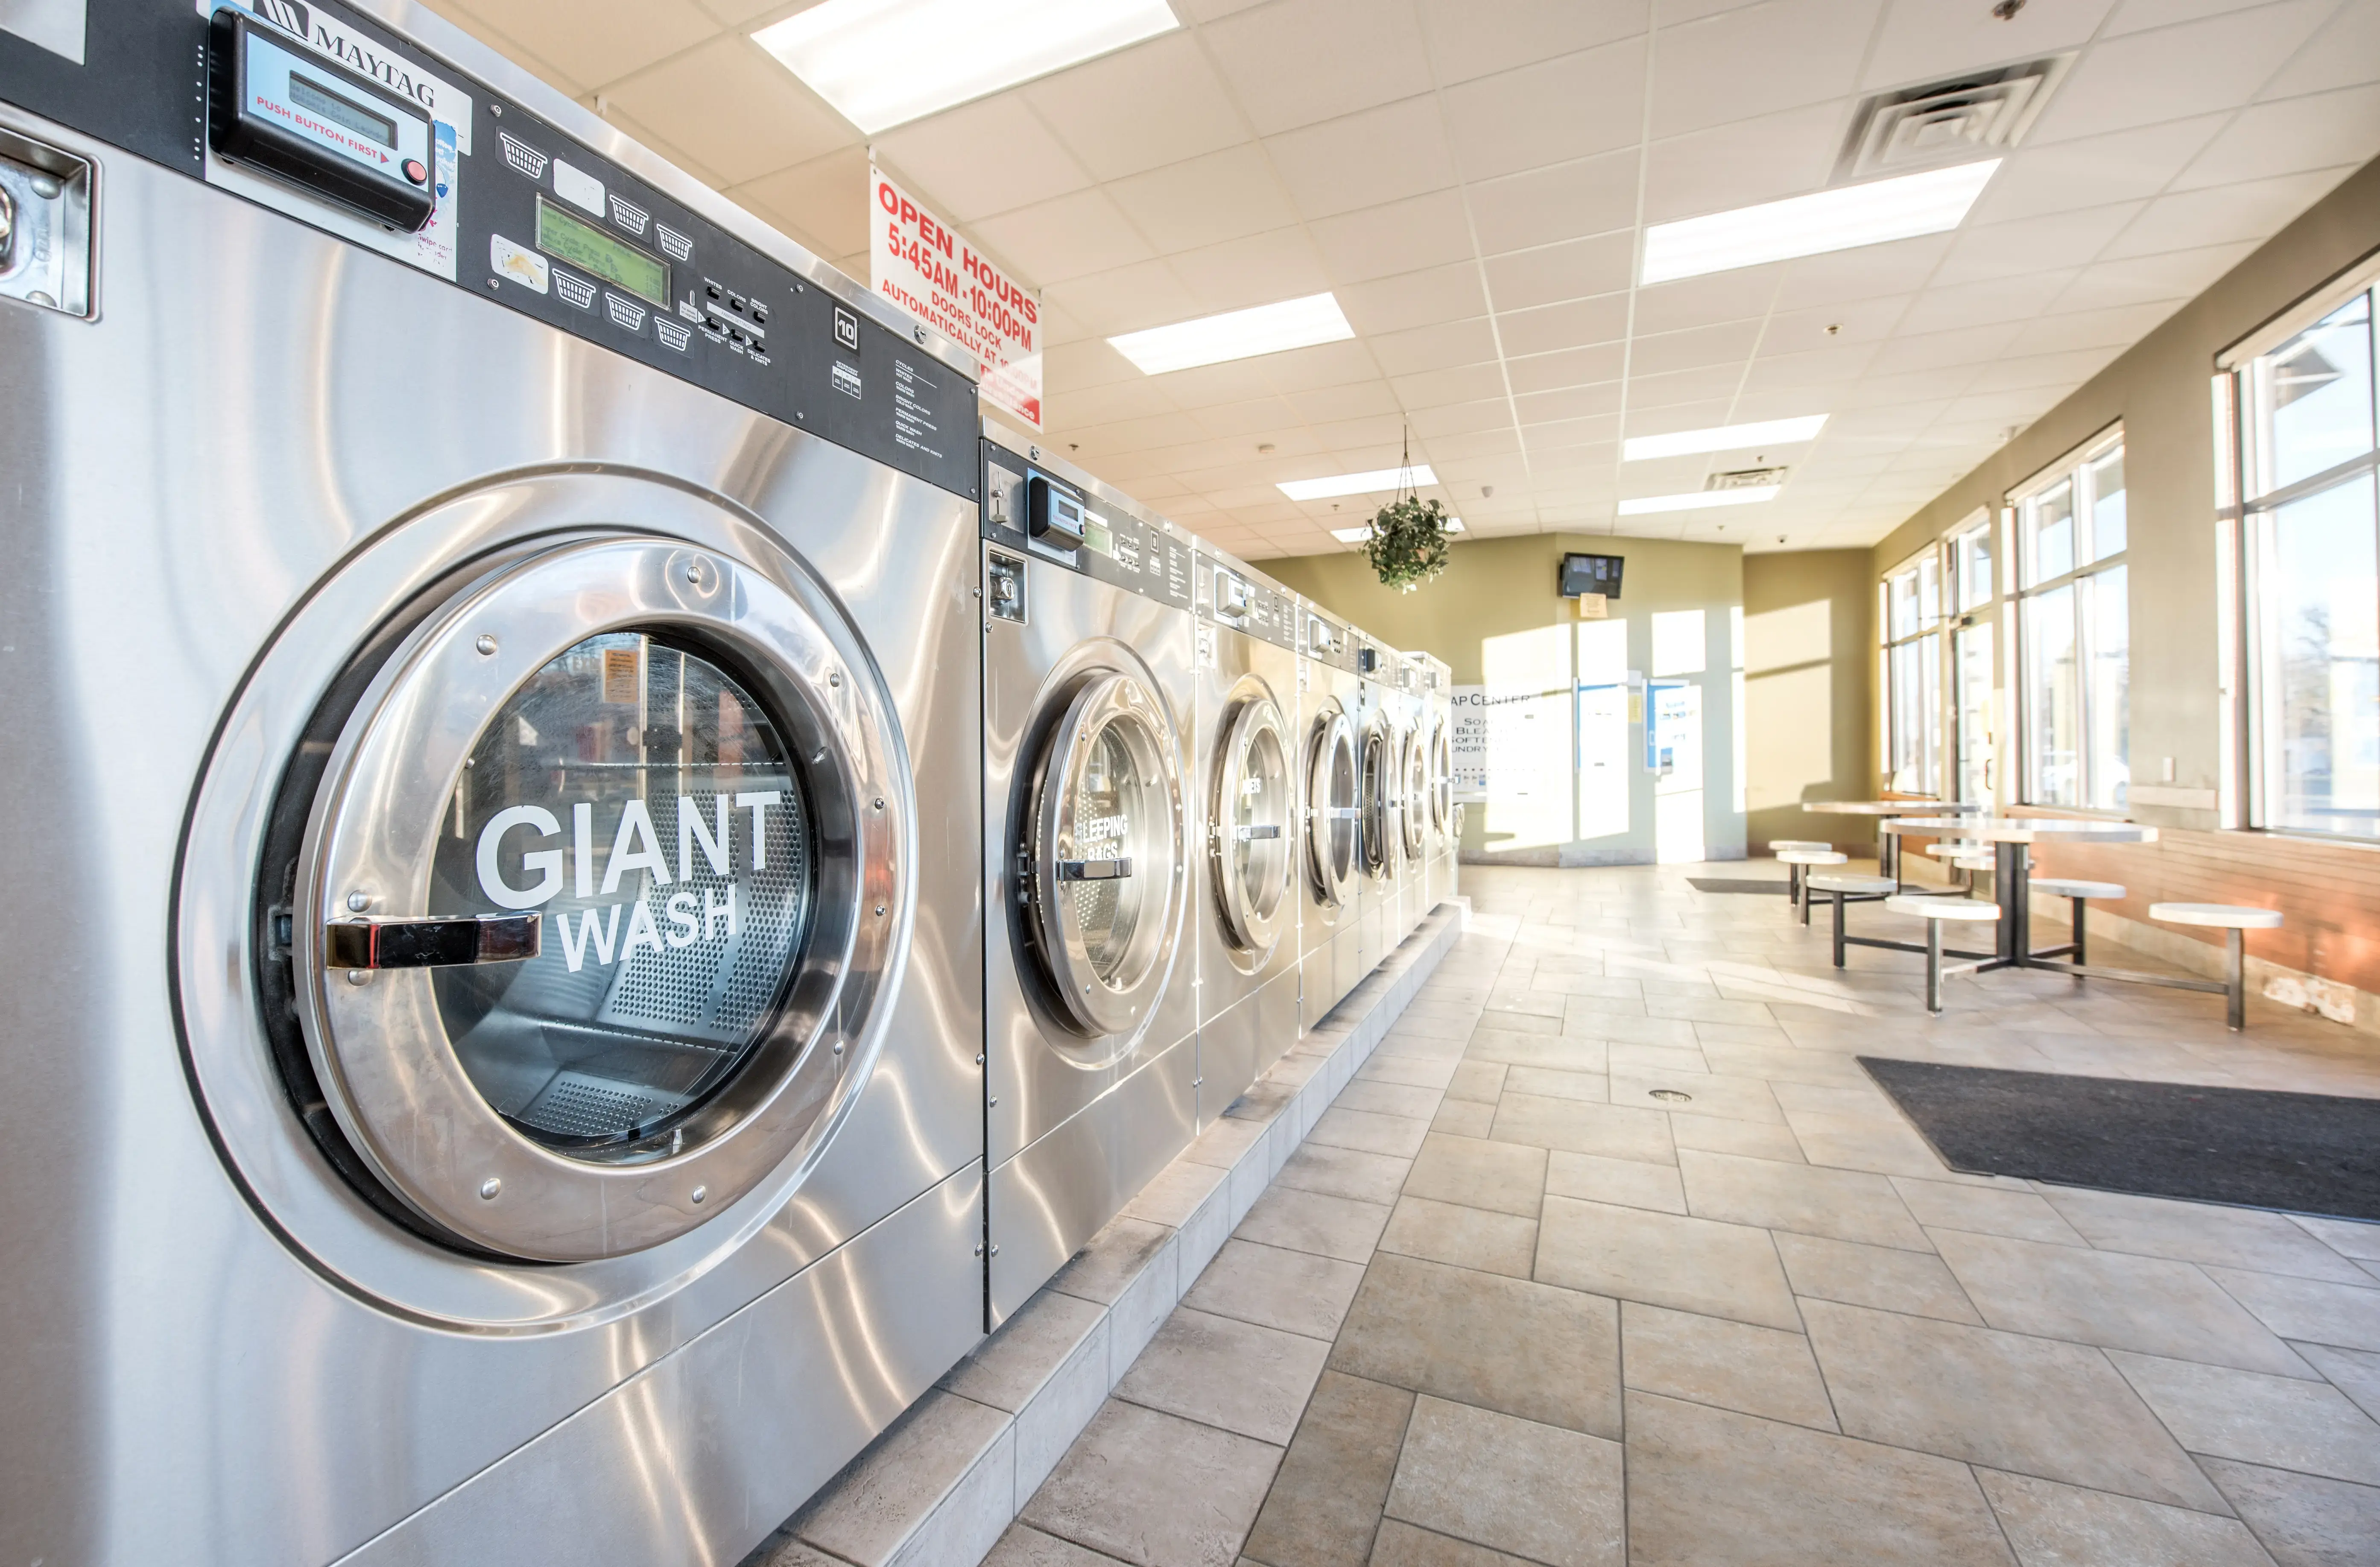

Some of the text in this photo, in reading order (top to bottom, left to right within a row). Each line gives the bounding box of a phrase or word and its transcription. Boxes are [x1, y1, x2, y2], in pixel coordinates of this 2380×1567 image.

[314, 23, 434, 108] MAYTAG
[290, 83, 342, 111] Welcome to
[330, 110, 351, 126] Coin
[257, 96, 377, 159] PUSH BUTTON FIRST
[879, 182, 1037, 324] OPEN HOURS
[704, 276, 722, 290] WHITES
[888, 222, 958, 299] 5:45AM
[970, 284, 1032, 352] 10:00PM
[727, 289, 746, 303] COLORS
[751, 298, 767, 309] BRIGHT
[750, 302, 768, 314] COLORS
[722, 311, 751, 330] FABRIC SETTINGS
[882, 279, 981, 354] AUTOMATICALLY
[985, 348, 996, 364] AT
[932, 290, 1002, 350] DOORS LOCK
[698, 325, 727, 342] PERMANENT
[838, 319, 854, 340] 10
[705, 334, 721, 343] PRESS
[729, 340, 744, 350] QUICK
[730, 345, 743, 354] WASH
[747, 349, 771, 363] DELICATES
[755, 355, 768, 366] KNITS
[836, 360, 858, 374] DETERGENT
[895, 360, 913, 372] CYCLES
[837, 363, 857, 376] DISPENSER
[896, 368, 912, 380] WHITES
[895, 381, 914, 393] COLORS
[895, 394, 931, 415] BRIGHT COLORS
[895, 407, 937, 431] PERMANENT PRESS
[895, 420, 922, 436] QUICK WASH
[895, 433, 919, 447] DELICATES
[930, 450, 942, 458] KNITS
[1451, 694, 1530, 706] AP CENTER
[1464, 718, 1488, 726] SOA
[1075, 814, 1128, 845] SLEEPING
[476, 791, 781, 909] GIANT
[1087, 841, 1118, 861] BAGS
[556, 883, 737, 973] WASH
